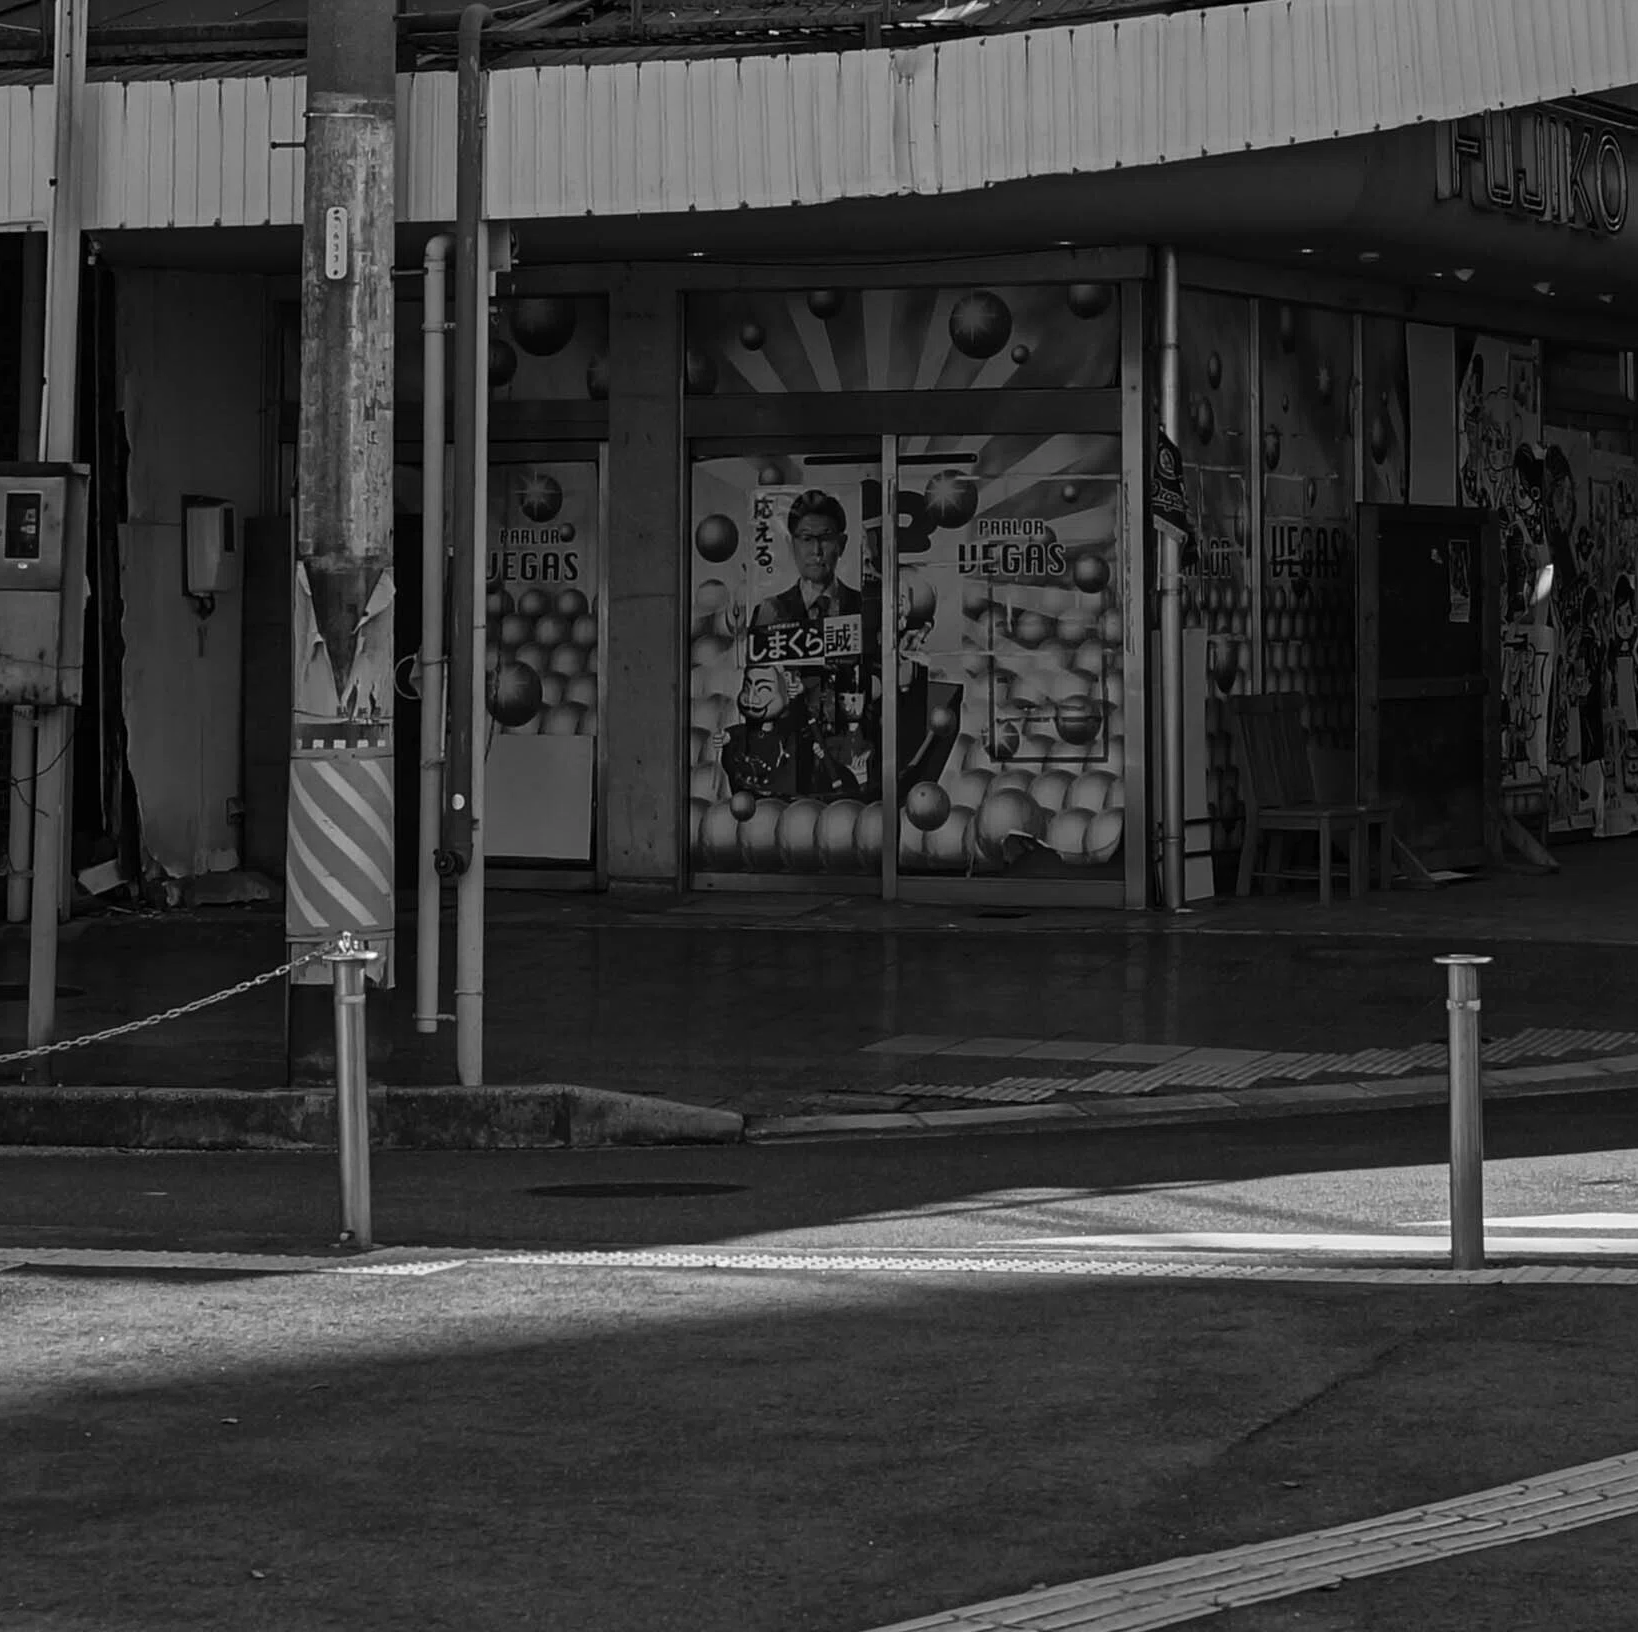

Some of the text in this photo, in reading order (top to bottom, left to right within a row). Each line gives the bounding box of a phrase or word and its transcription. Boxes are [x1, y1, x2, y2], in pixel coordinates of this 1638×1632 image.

[500, 528, 560, 544] PARLOR
[754, 496, 774, 575] 応える。
[979, 519, 1045, 536] PARLOR
[958, 543, 1066, 574] VEGAS
[1271, 526, 1341, 578] VEGAS
